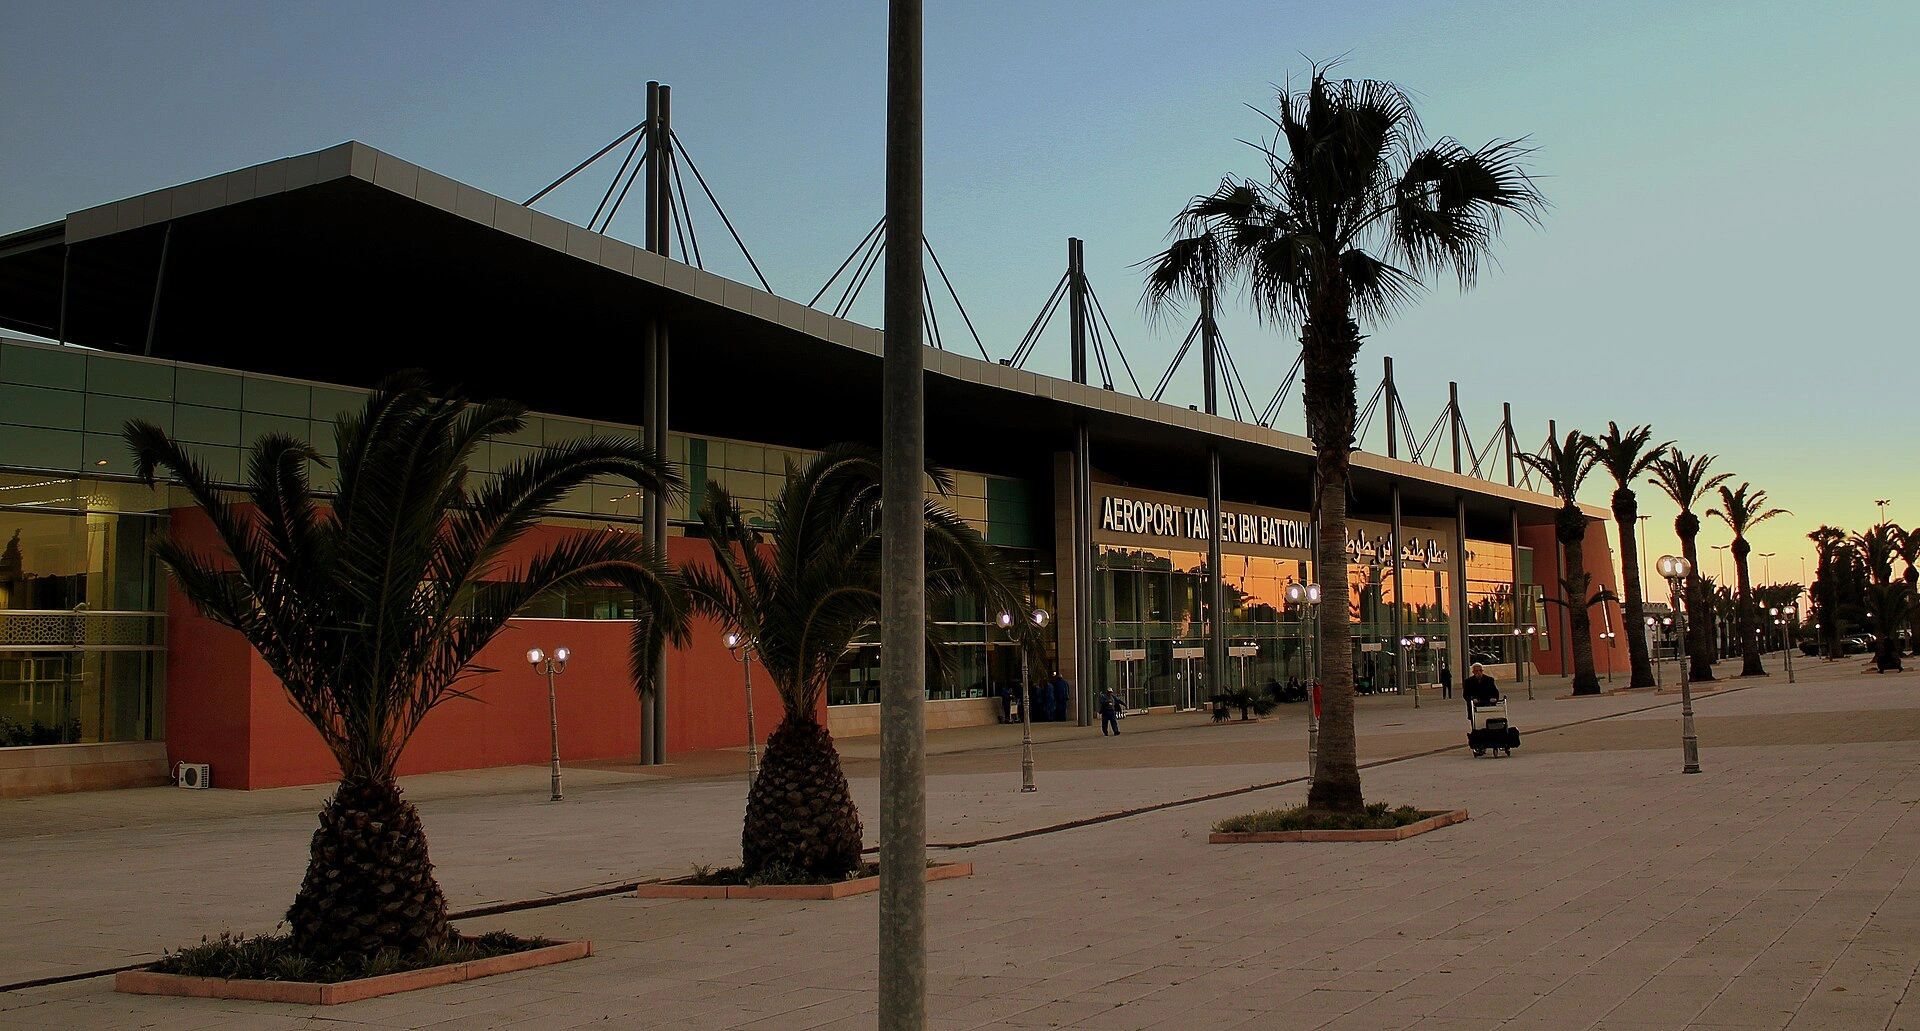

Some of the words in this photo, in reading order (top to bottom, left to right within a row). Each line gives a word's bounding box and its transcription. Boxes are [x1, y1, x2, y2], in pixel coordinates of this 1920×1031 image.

[1102, 496, 1182, 536] AEROPORT
[1184, 507, 1236, 542] TANER
[1239, 513, 1258, 544] IBN
[1345, 527, 1377, 565] بطوط
[1400, 537, 1425, 568] طنج
[1424, 539, 1449, 569] مطار
